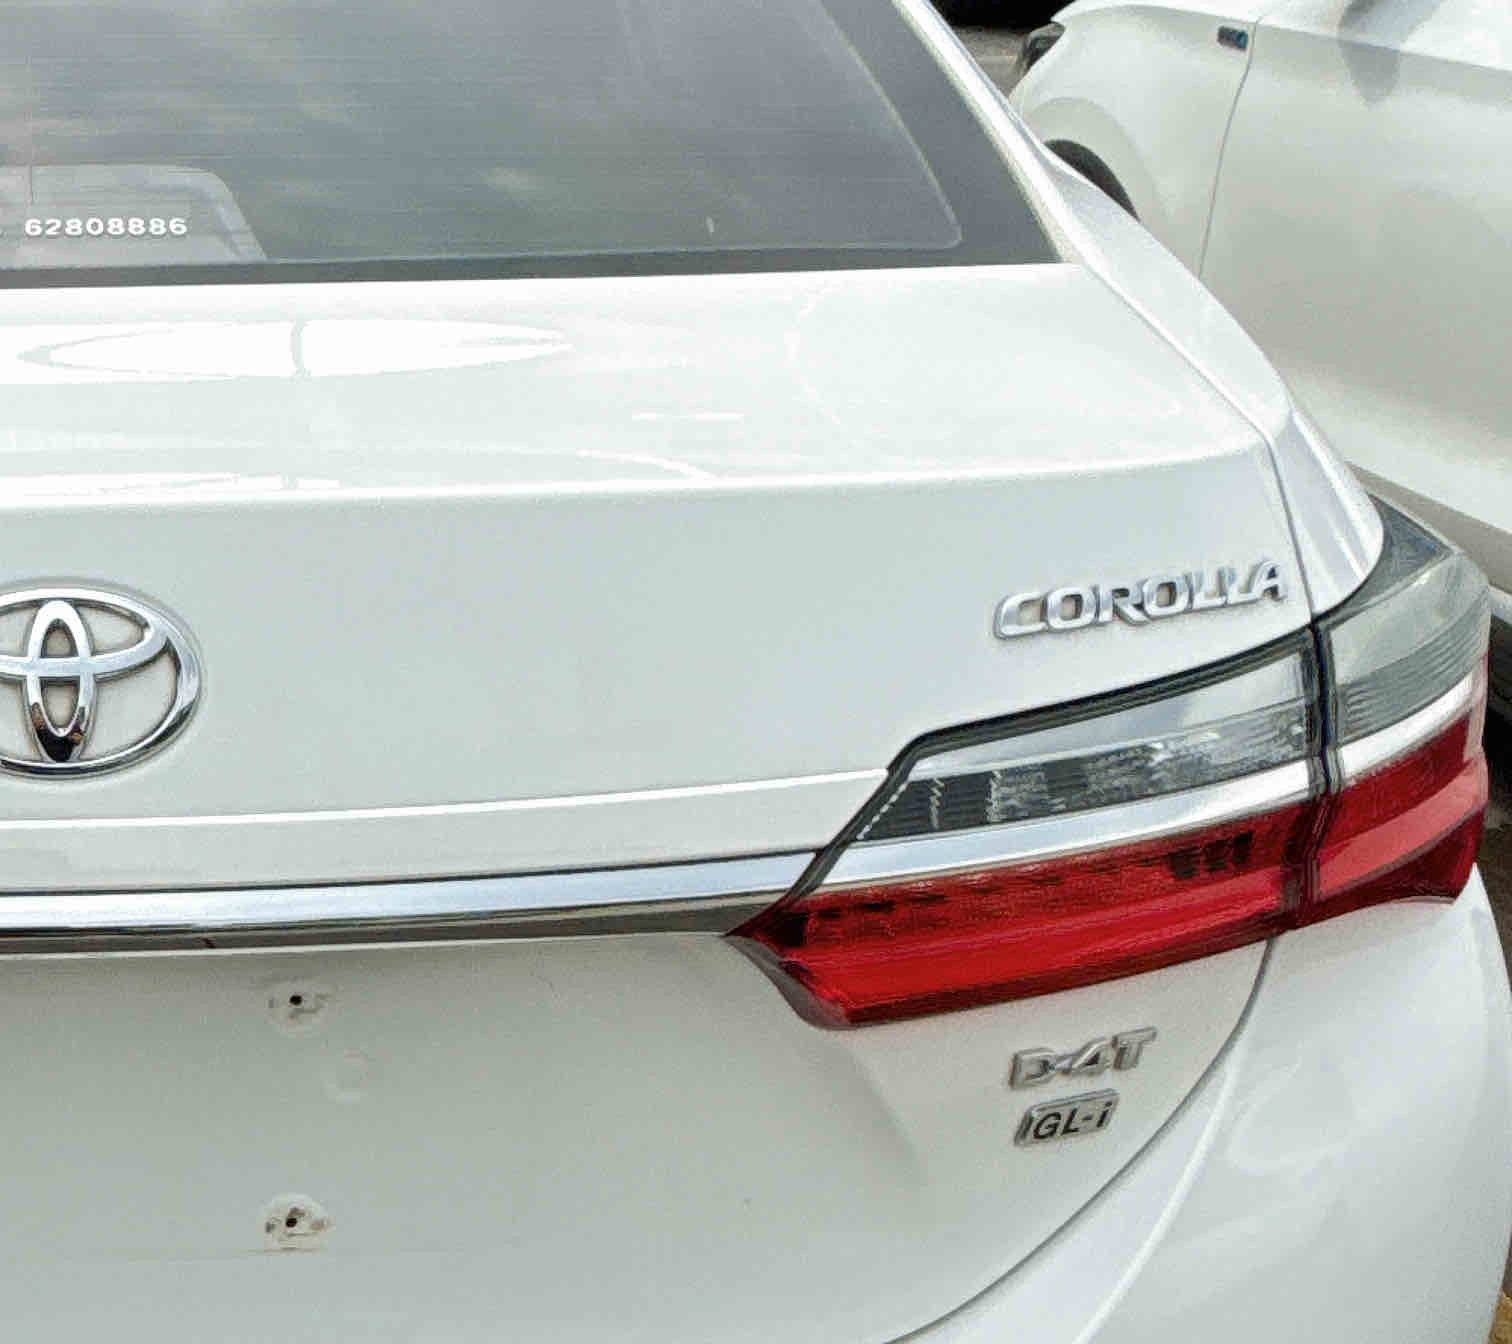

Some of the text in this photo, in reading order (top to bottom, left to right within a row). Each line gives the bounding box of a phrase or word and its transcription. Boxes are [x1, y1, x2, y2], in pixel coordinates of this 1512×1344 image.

[24, 217, 188, 237] 62808886
[993, 558, 1290, 641] COROLLA
[1008, 1025, 1158, 1091] D-4T
